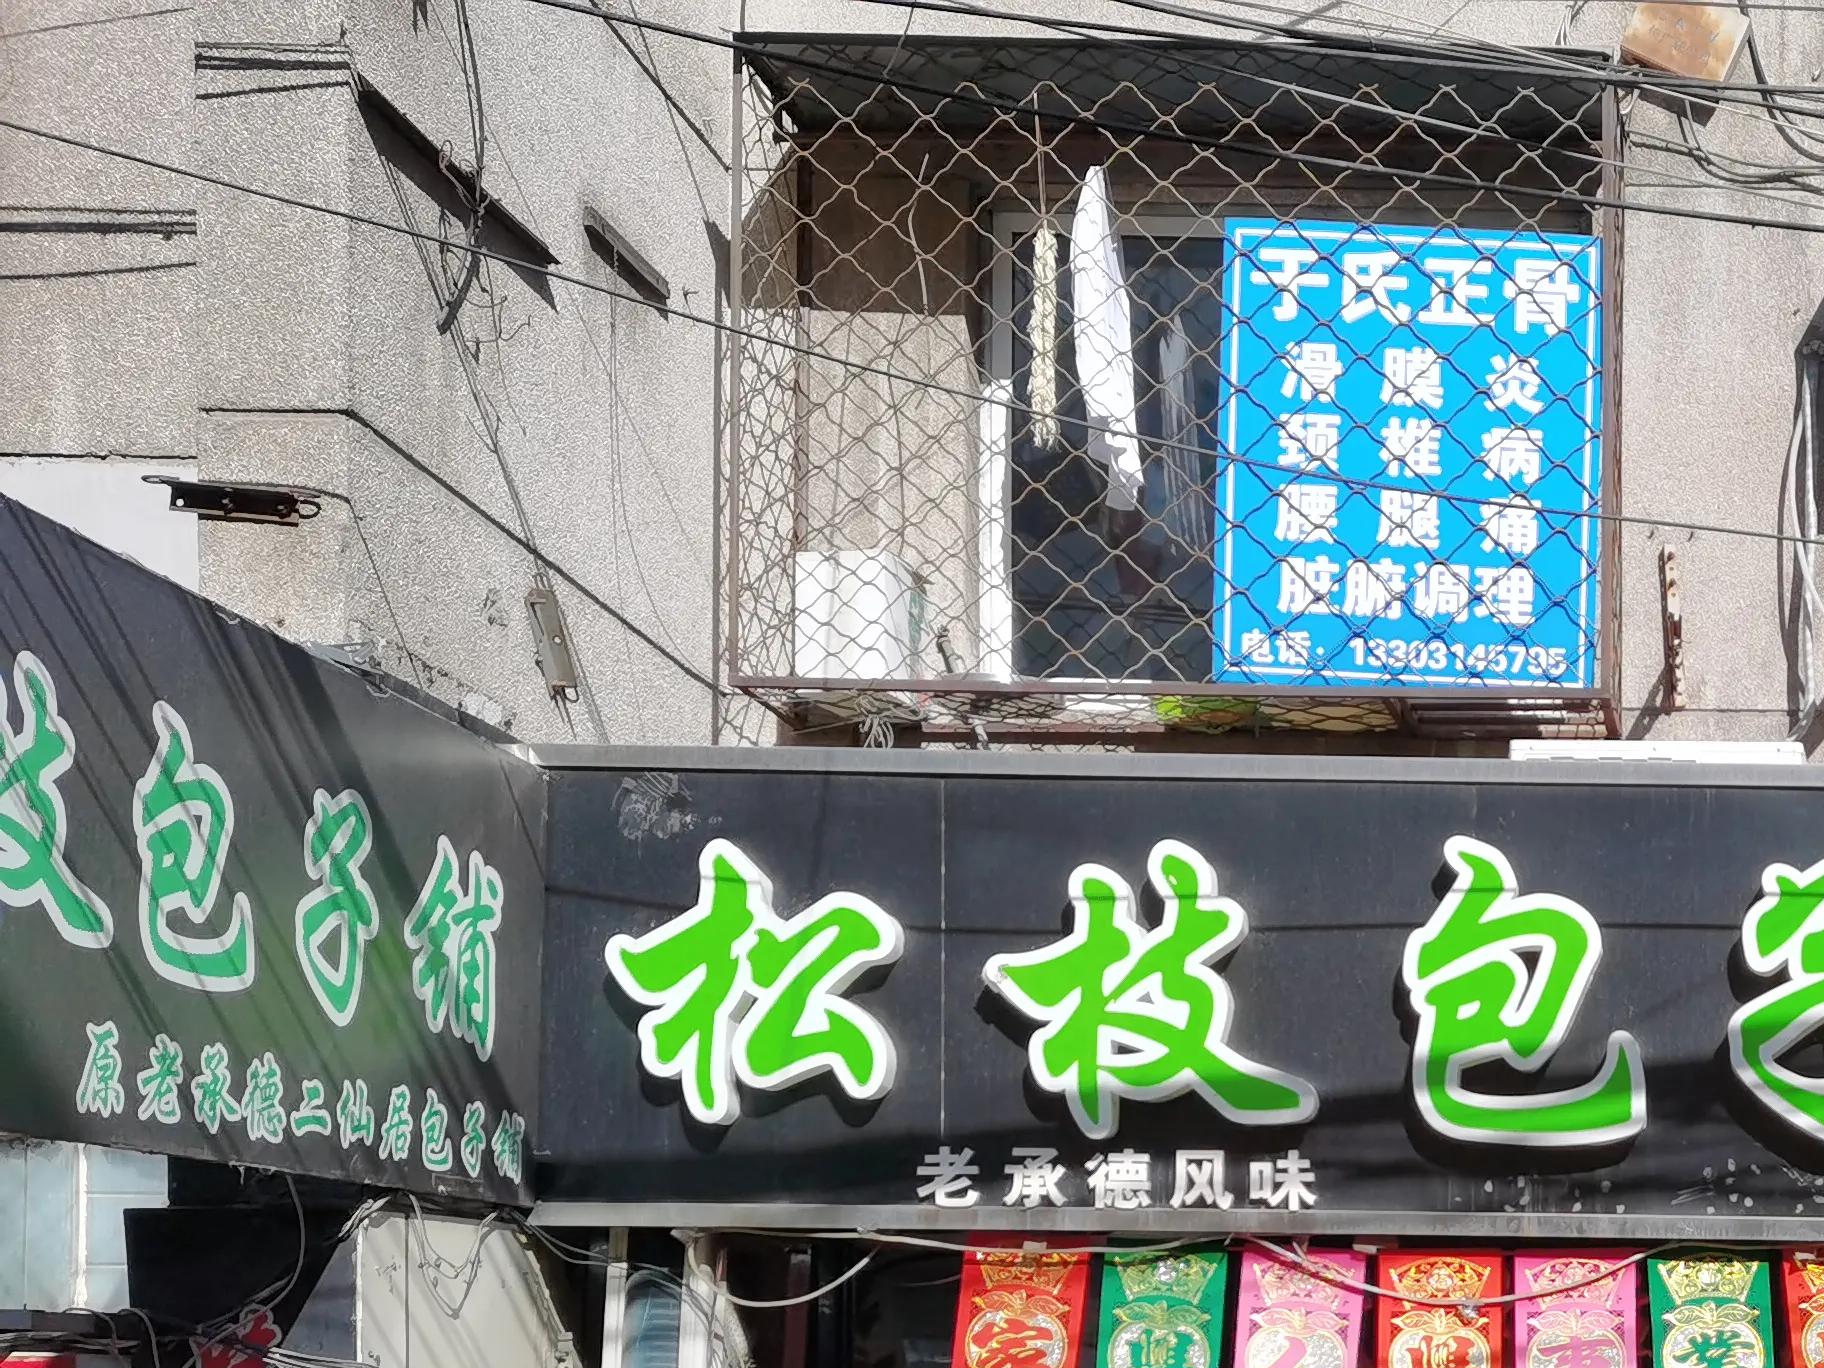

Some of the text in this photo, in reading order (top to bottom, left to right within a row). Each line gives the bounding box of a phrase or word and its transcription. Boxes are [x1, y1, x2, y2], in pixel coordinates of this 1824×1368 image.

[1249, 248, 1580, 335] 于氏正骨
[1280, 341, 1544, 413] 滑膜炎
[1276, 413, 1543, 484] 颈椎病
[1274, 484, 1542, 553] 腰腿痛
[1277, 556, 1535, 625] 脏腑调理
[916, 1146, 1318, 1212] 老承德风味
